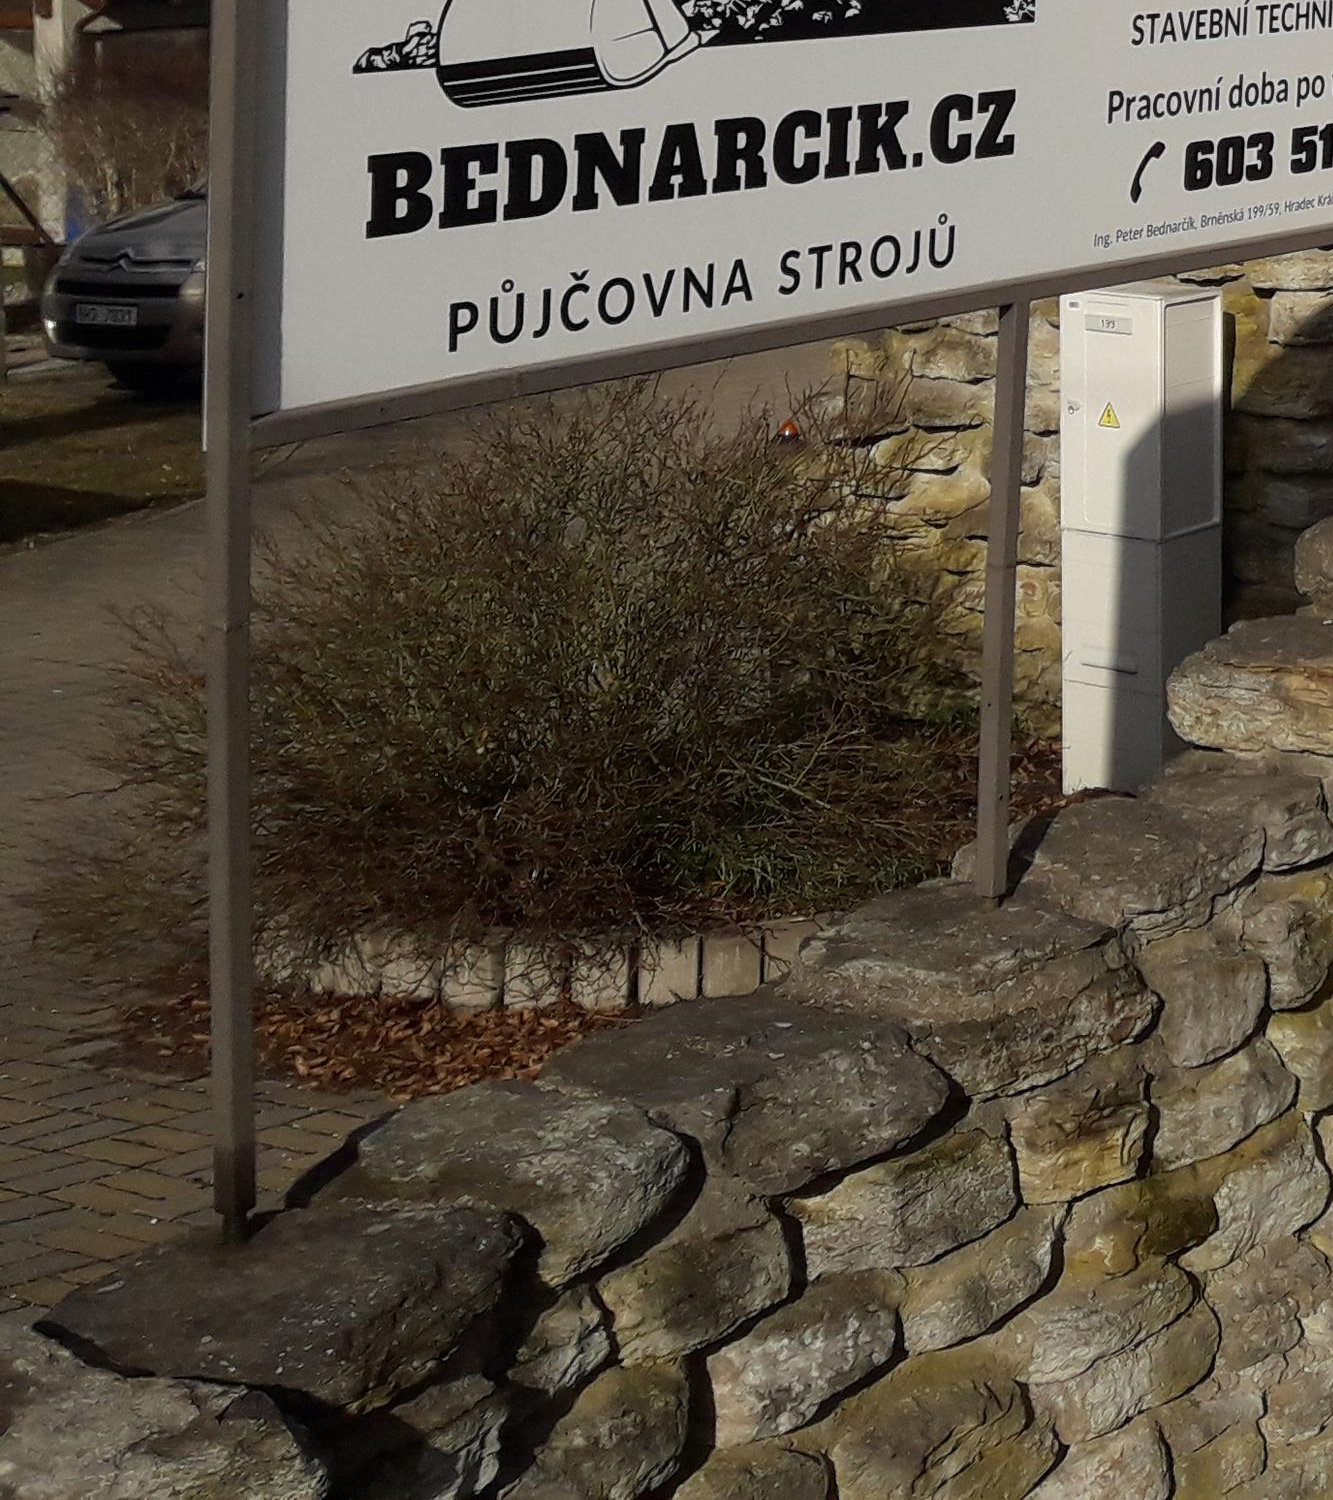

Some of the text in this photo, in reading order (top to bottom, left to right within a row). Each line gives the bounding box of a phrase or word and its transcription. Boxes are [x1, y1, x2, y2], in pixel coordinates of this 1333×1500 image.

[1107, 76, 1224, 124] Pracovní
[1228, 71, 1289, 109] doba
[1297, 76, 1325, 108] po
[365, 88, 1017, 240] BEDNARCIK.CZ
[1184, 131, 1274, 192] 603
[1093, 233, 1113, 249] Ing.
[1115, 228, 1144, 243] Peter
[1200, 208, 1244, 228] Brněnská
[1247, 202, 1282, 220] 199/59,
[1284, 197, 1315, 213] Hradec
[447, 212, 959, 353] PŮJČOVNA STROJŮ
